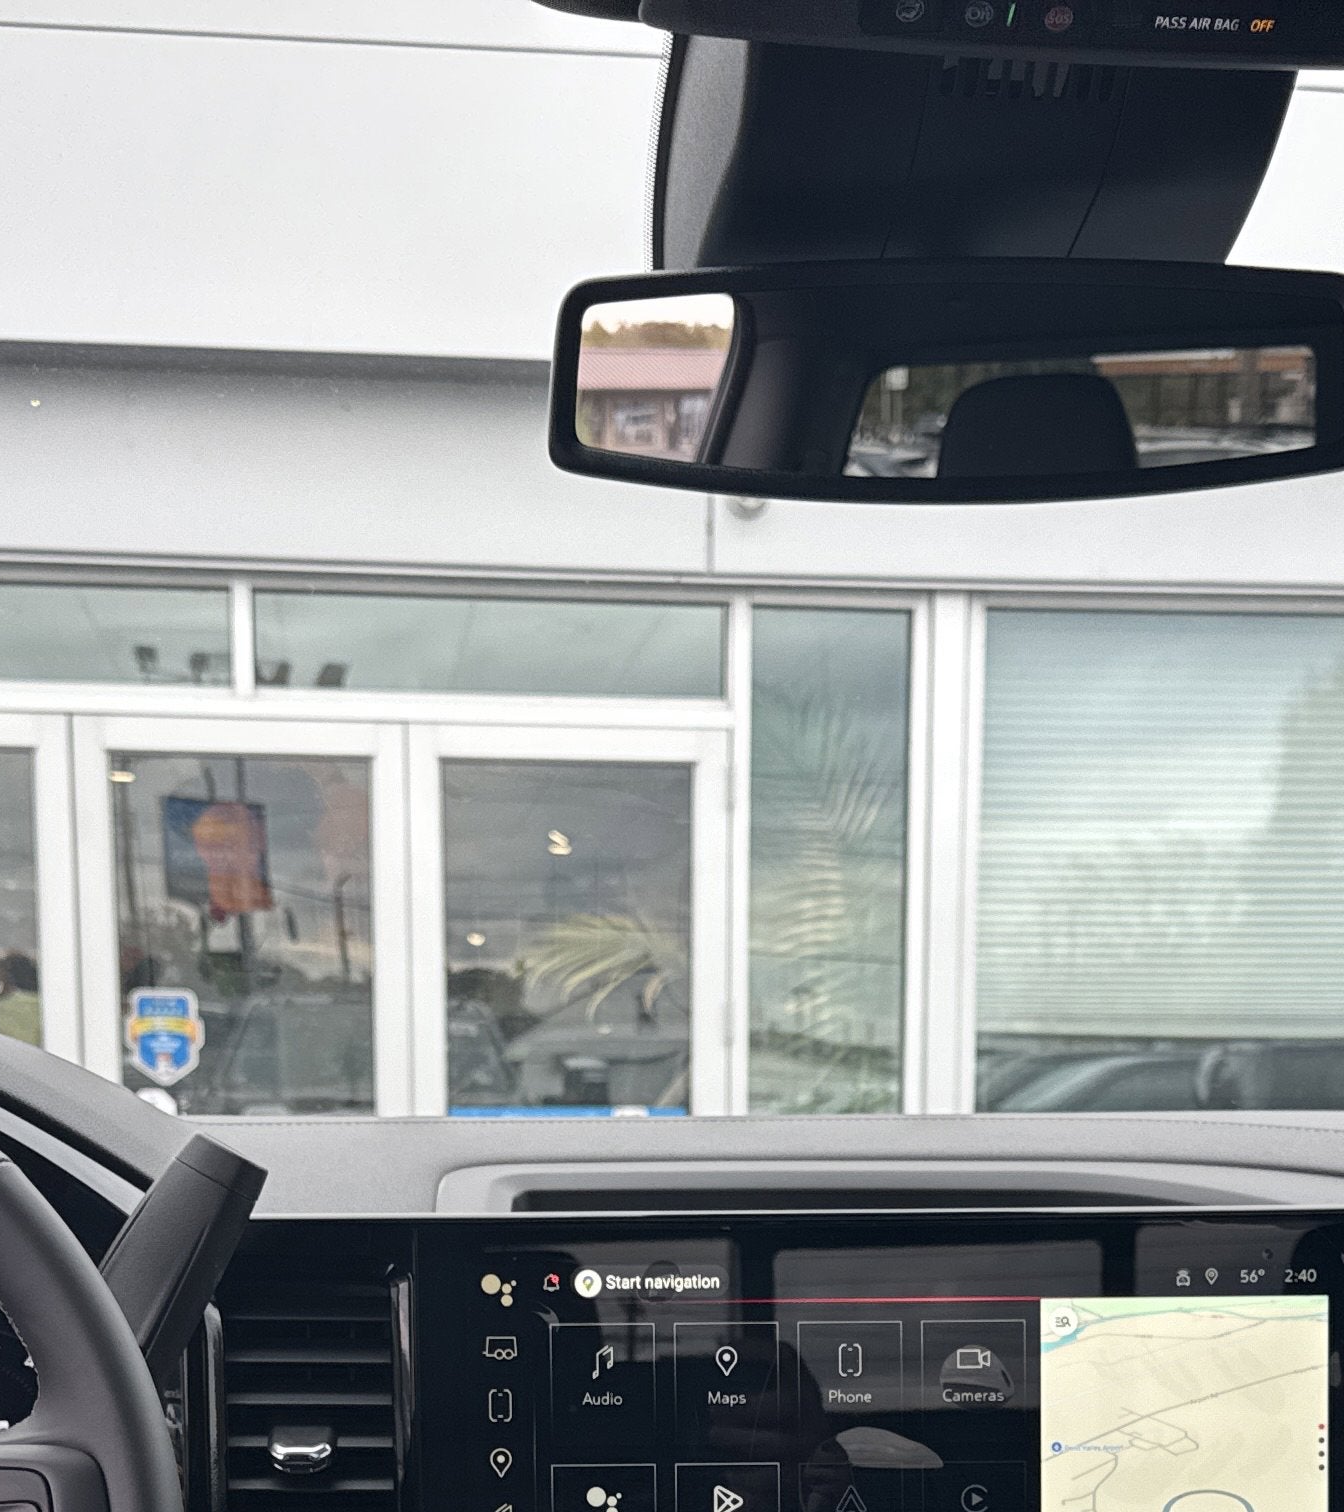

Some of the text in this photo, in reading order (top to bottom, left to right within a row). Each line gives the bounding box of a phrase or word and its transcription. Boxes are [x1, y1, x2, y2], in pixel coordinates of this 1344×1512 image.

[1155, 16, 1274, 32] PASS AIR BAG OFF
[606, 1274, 720, 1292] Start navigation
[1285, 1269, 1317, 1283] 2:40
[582, 1392, 623, 1406] Audio
[708, 1391, 747, 1407] Maps
[828, 1389, 872, 1403] Phone
[942, 1388, 1005, 1402] Cameras
